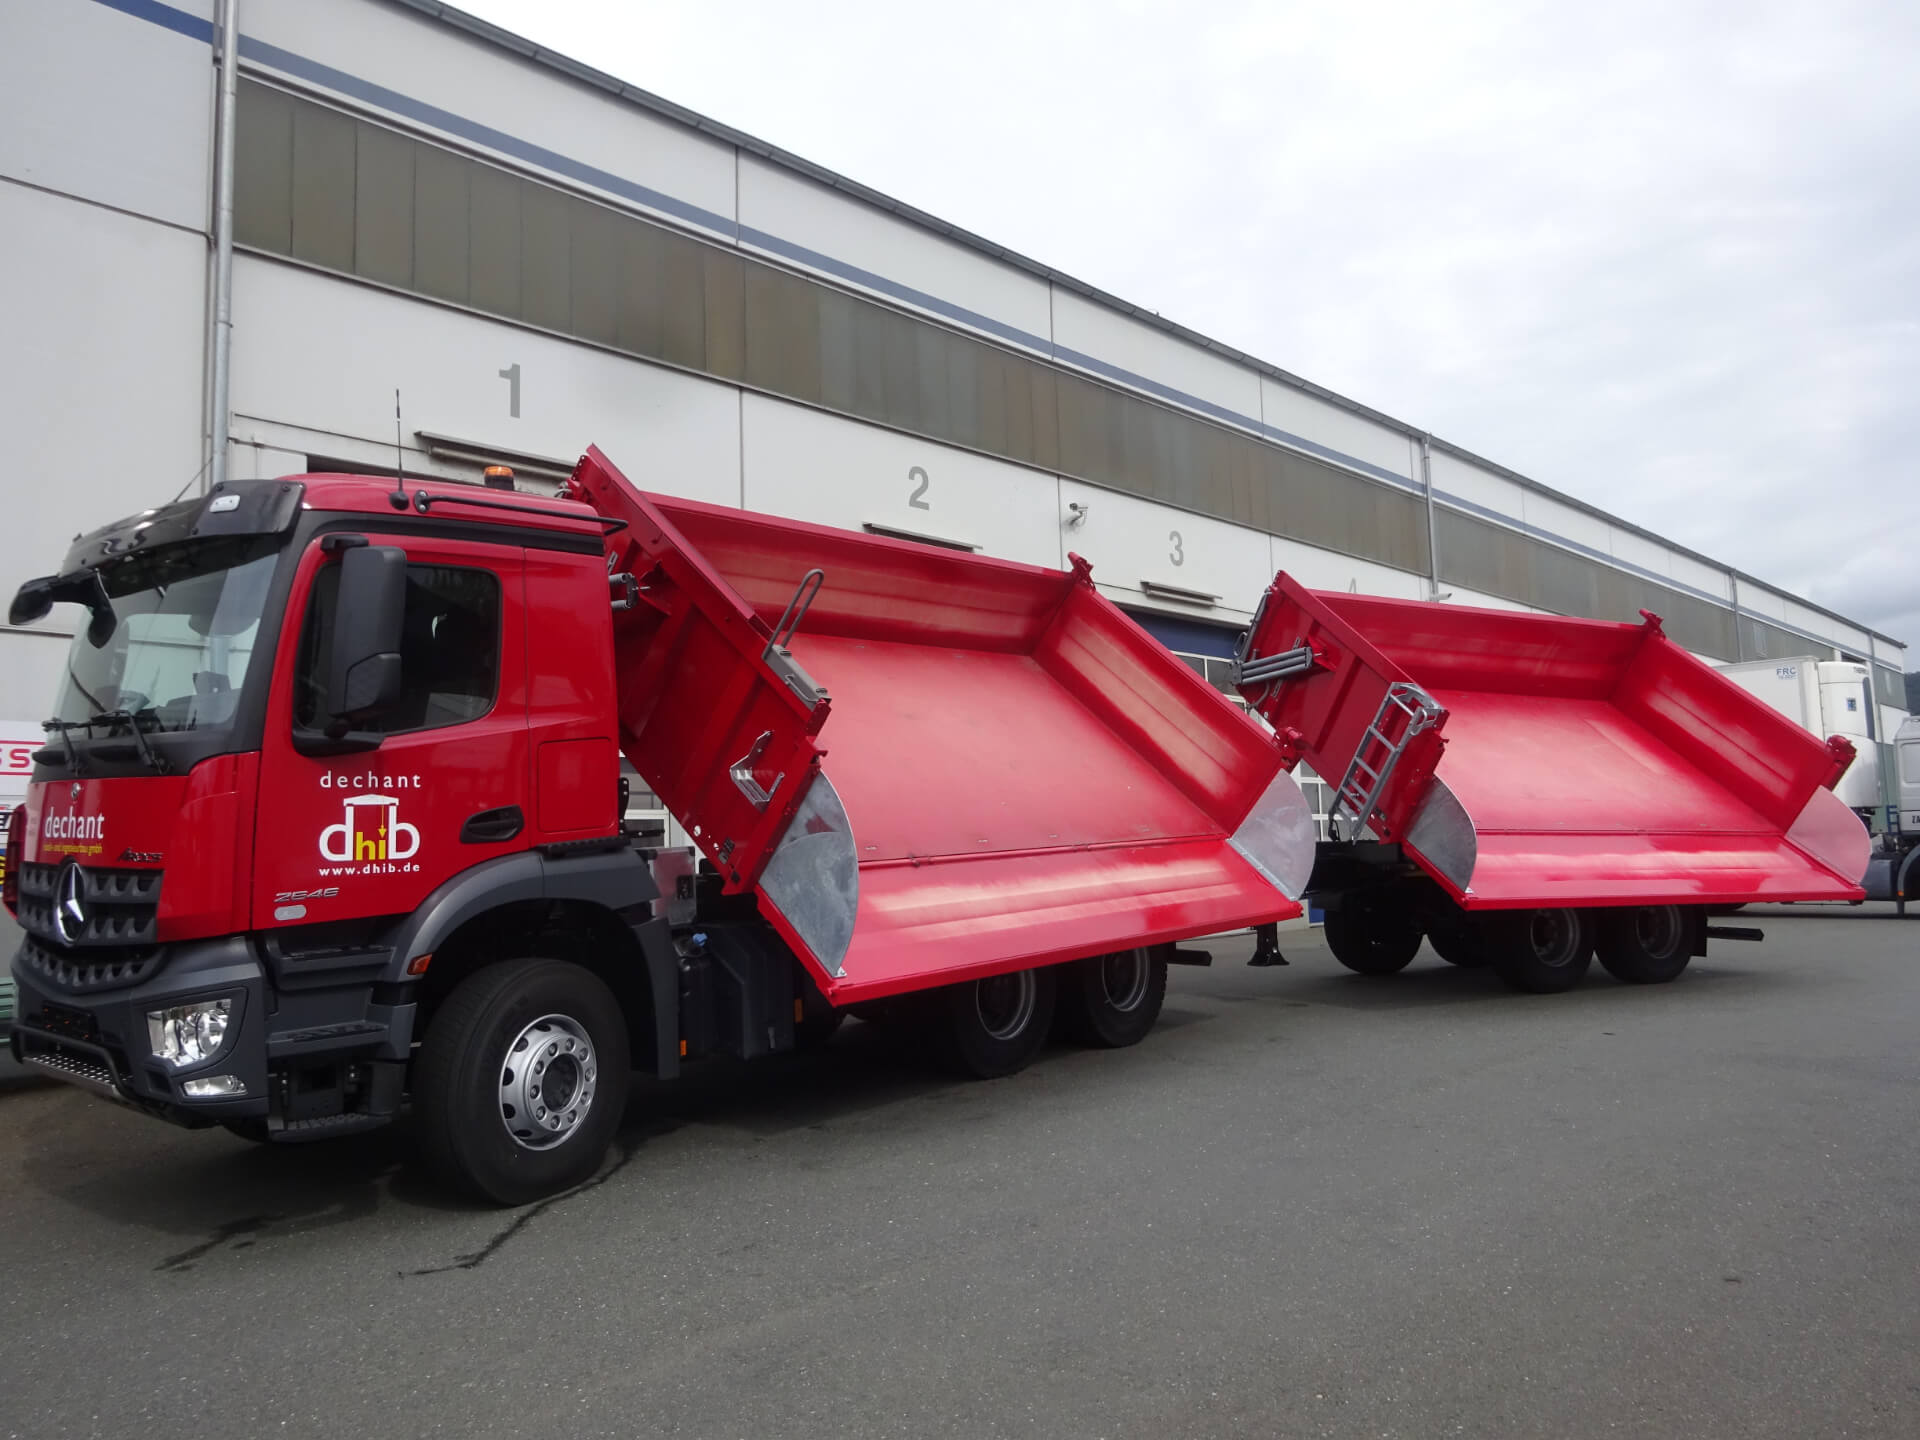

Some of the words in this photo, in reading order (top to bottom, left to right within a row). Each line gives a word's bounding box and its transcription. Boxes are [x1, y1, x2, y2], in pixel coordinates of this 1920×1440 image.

[498, 363, 521, 418] 1
[908, 466, 930, 510] 2
[1168, 530, 1184, 567] 3
[319, 770, 421, 788] dechant
[45, 805, 105, 839] dechant
[319, 805, 420, 861] dhib
[319, 862, 421, 877] www.dhib.de
